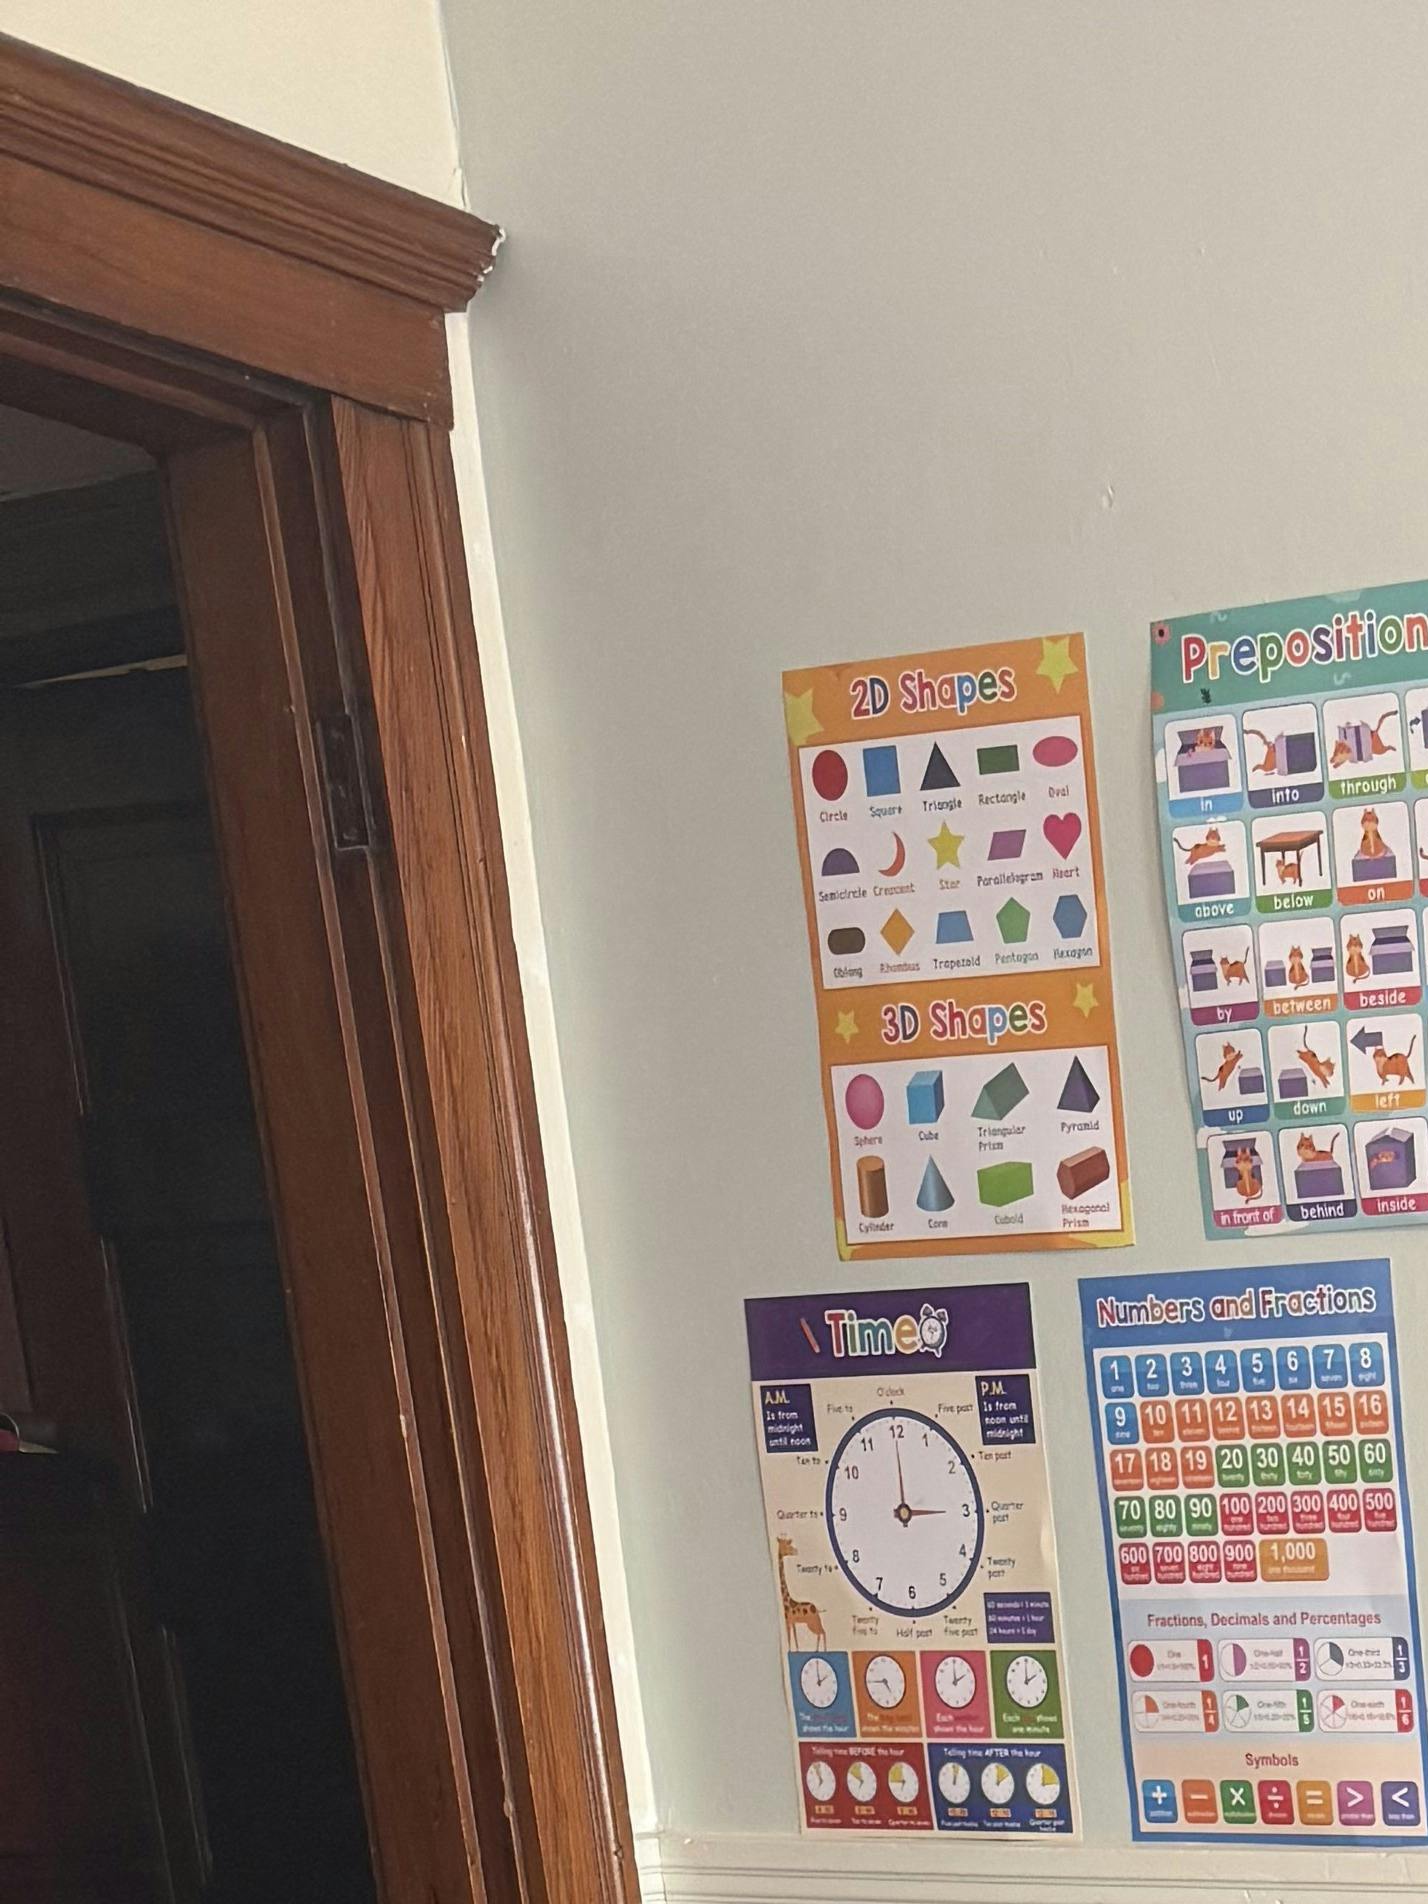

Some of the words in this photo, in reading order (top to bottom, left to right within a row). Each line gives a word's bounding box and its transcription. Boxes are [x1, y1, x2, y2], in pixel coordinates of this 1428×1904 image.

[850, 678, 889, 720] 2D
[900, 668, 1016, 715] Shapes
[1341, 777, 1396, 796] through
[978, 791, 1026, 805] Rectangle
[1272, 789, 1299, 803] into
[923, 798, 962, 811] Triangle
[820, 811, 848, 822] Circle
[1274, 894, 1313, 910] below
[1359, 991, 1406, 1006] beside
[1273, 999, 1331, 1014] between
[881, 1005, 920, 1043] 3D
[929, 1000, 1046, 1045] Shapes
[1293, 1102, 1326, 1115] down
[1373, 1094, 1400, 1109] left
[1061, 1121, 1099, 1132] Pyramid
[1301, 1203, 1344, 1219] behind
[1097, 1291, 1204, 1328] Numbers
[1210, 1294, 1255, 1320] and
[1260, 1284, 1376, 1319] Fractions
[824, 1310, 922, 1358] Time
[1360, 1348, 1372, 1368] 8
[889, 1426, 904, 1438] 12
[1221, 1448, 1243, 1469] 20
[845, 1467, 858, 1479] 10
[1222, 1497, 1249, 1515] 100
[1365, 1493, 1393, 1511] 500
[839, 1508, 847, 1520] 9
[1271, 1541, 1315, 1561] 1,000
[1211, 1612, 1268, 1626] Decimals
[1273, 1613, 1296, 1625] and
[1301, 1612, 1381, 1627] Percentages
[1246, 1753, 1299, 1768] Symbols
